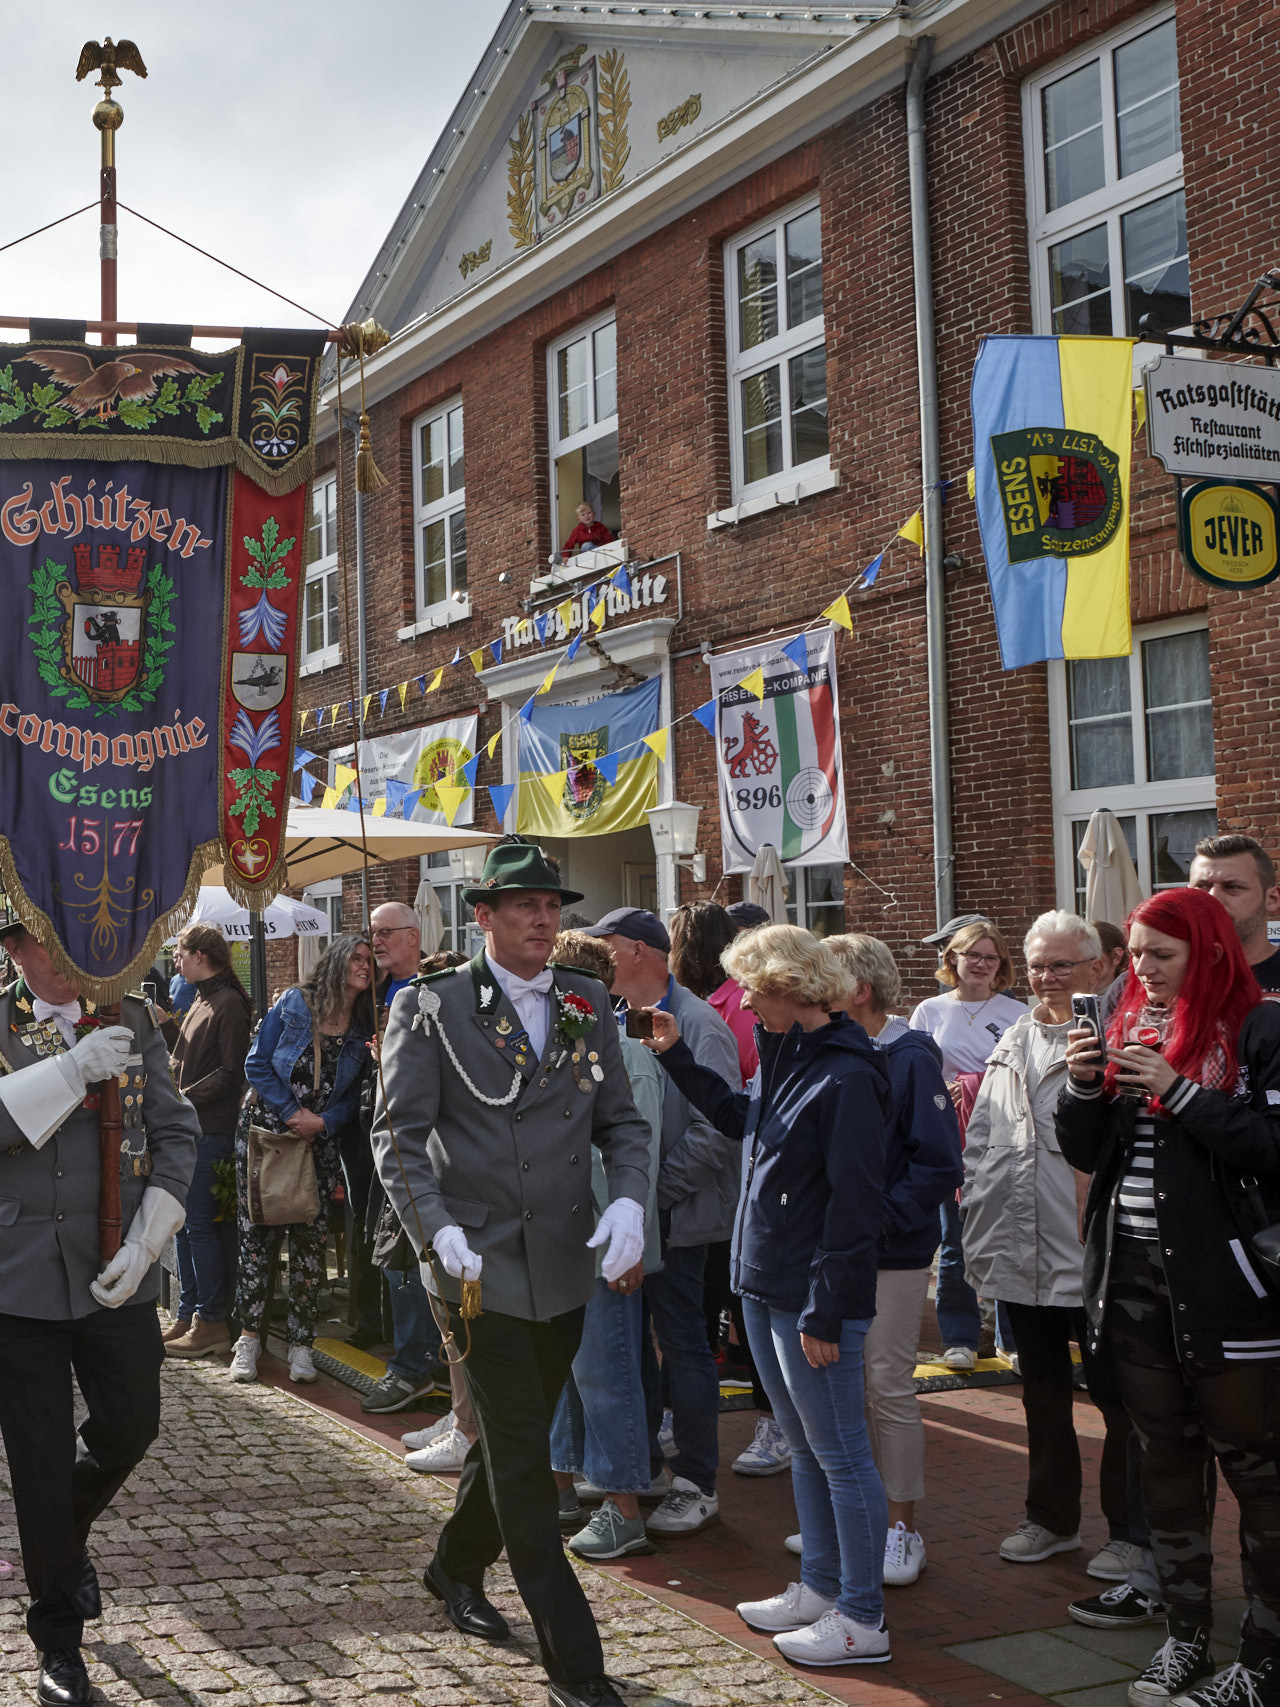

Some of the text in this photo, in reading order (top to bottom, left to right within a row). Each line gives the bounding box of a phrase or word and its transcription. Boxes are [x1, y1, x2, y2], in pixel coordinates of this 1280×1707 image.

[1156, 381, 1280, 422] Ratsgaststätt
[1026, 433, 1054, 447] e.V.
[1062, 435, 1097, 453] 1577
[1190, 417, 1262, 439] Restaurant
[1, 476, 214, 558] Schützen-
[1001, 457, 1035, 536] ESENS
[1204, 515, 1263, 557] JEVER
[568, 733, 599, 749] ESENS
[48, 768, 154, 811] Esens
[58, 815, 144, 856] 1577
